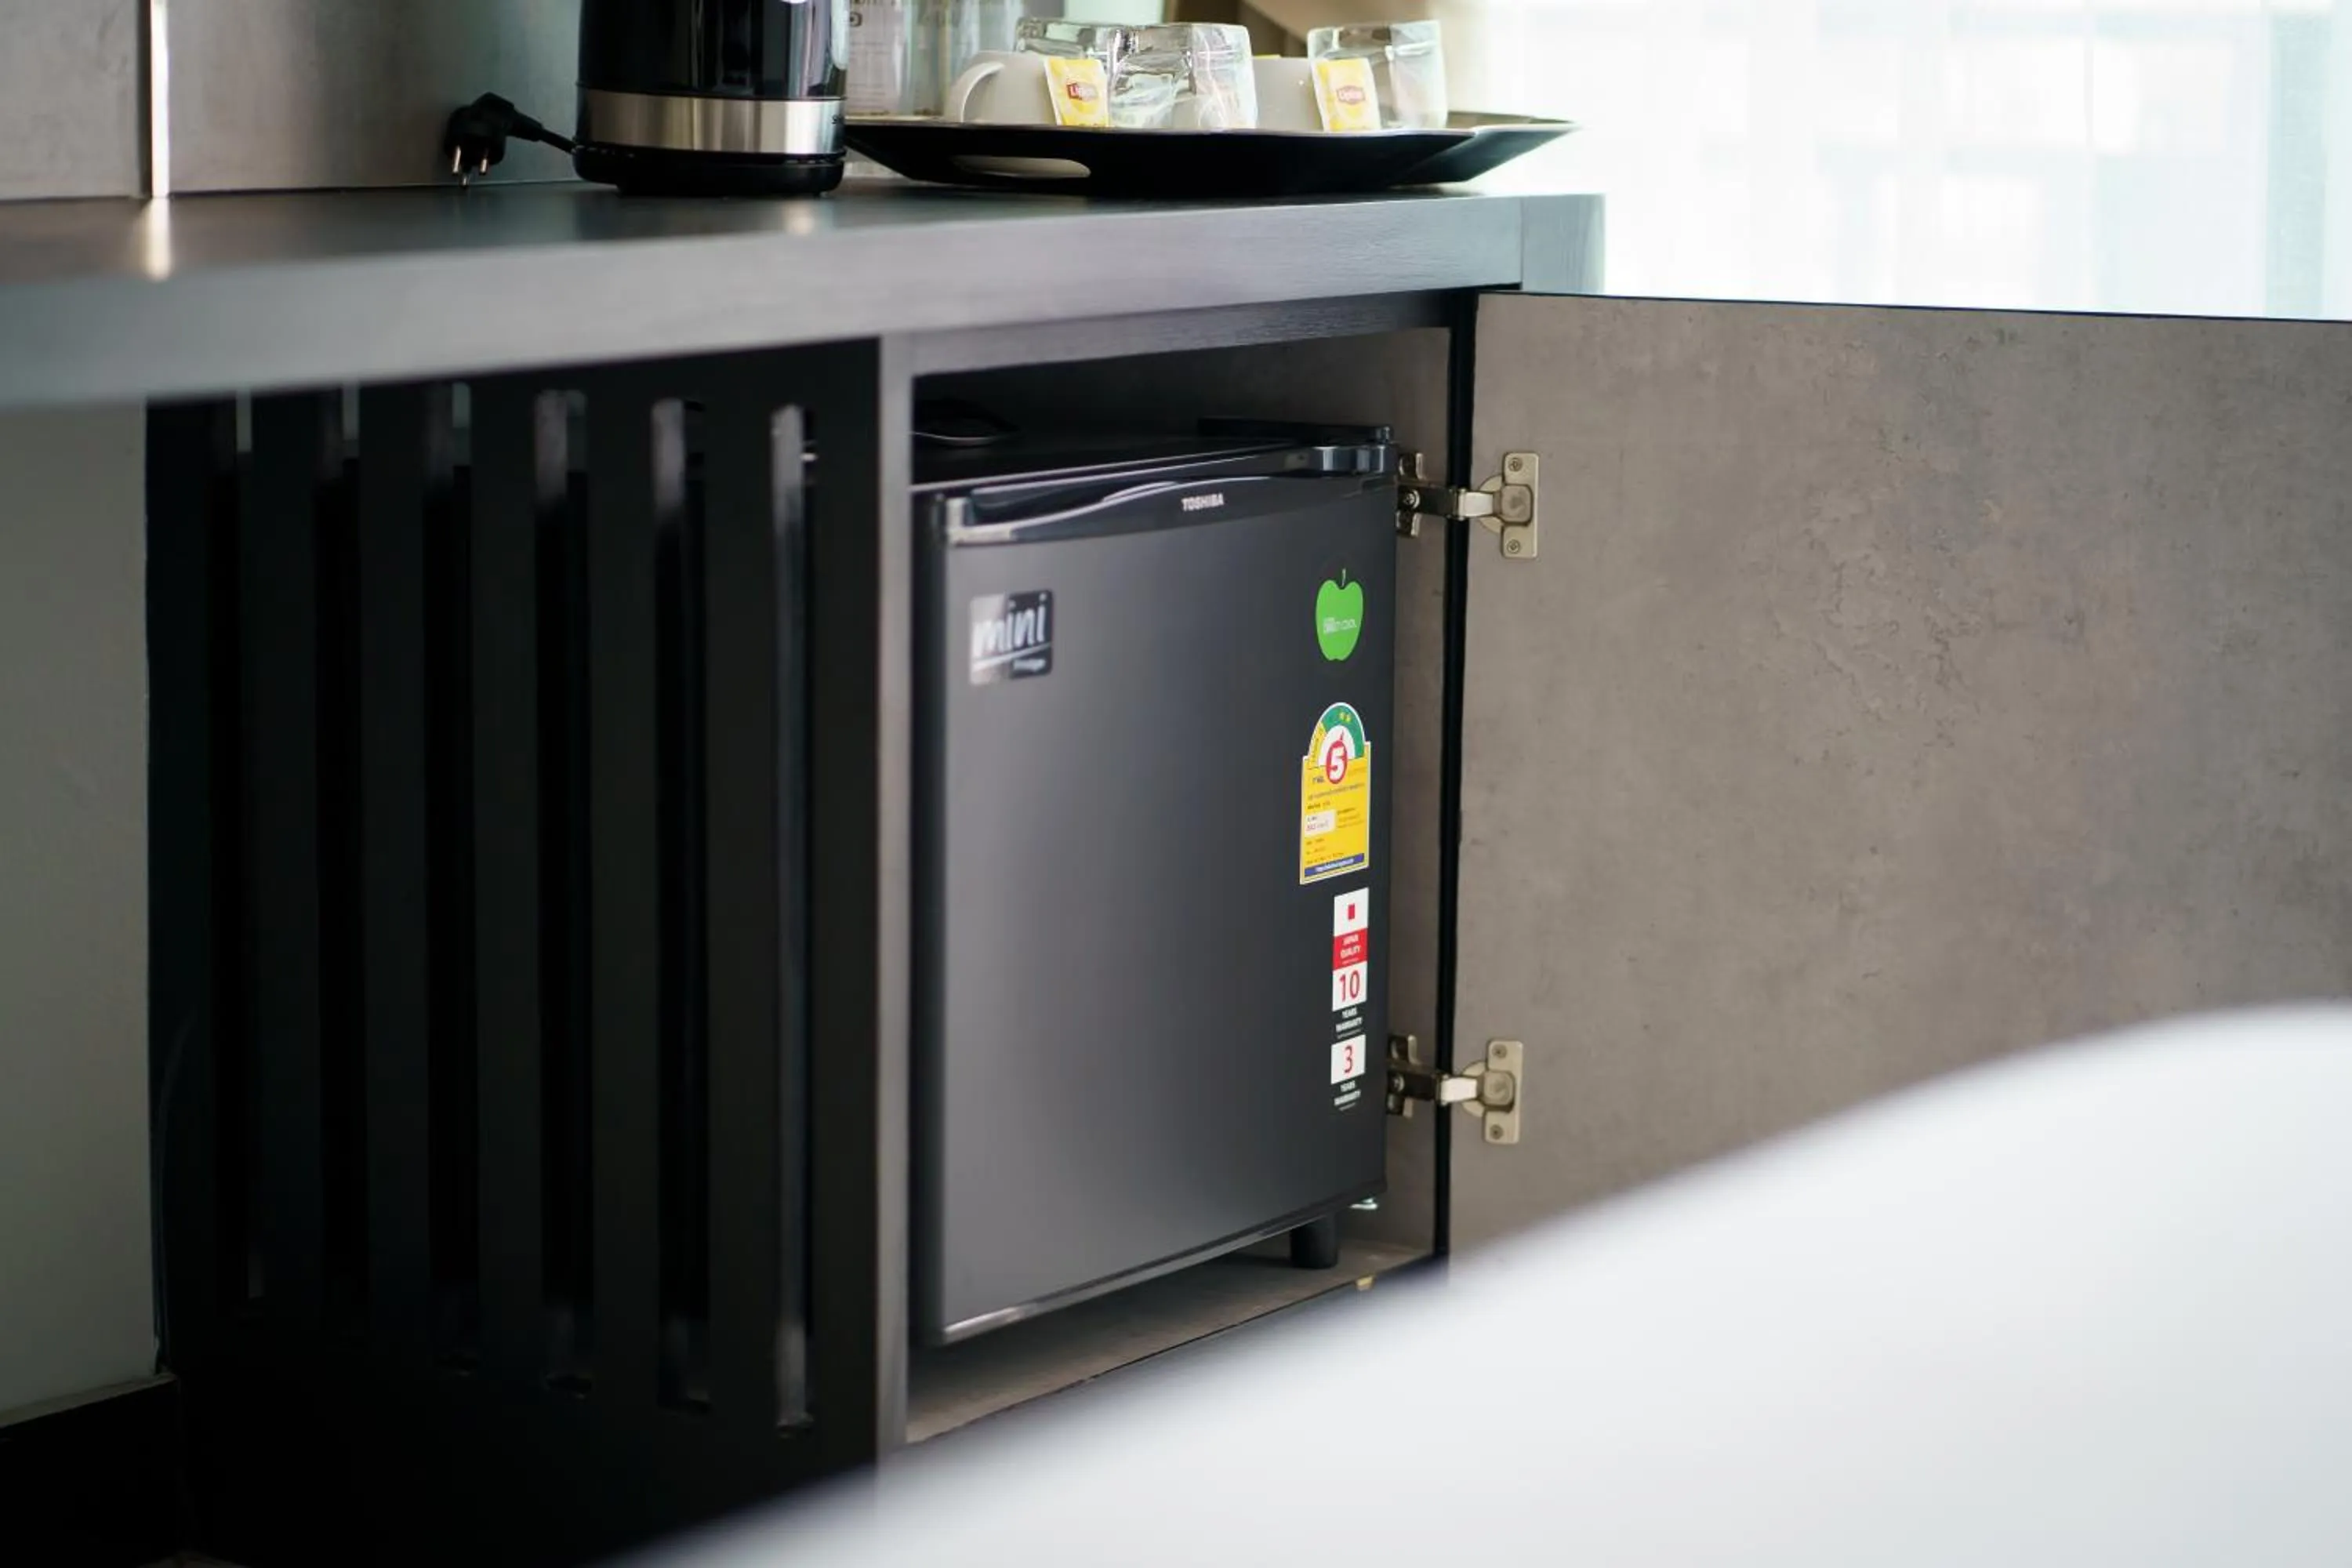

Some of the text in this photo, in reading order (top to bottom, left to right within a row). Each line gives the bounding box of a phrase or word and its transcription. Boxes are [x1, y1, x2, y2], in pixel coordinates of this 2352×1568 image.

[1181, 492, 1224, 511] TOSHIBA
[971, 593, 1046, 657] mini
[1330, 747, 1345, 781] 5
[1340, 971, 1360, 1002] 10
[1345, 1045, 1353, 1073] 3
